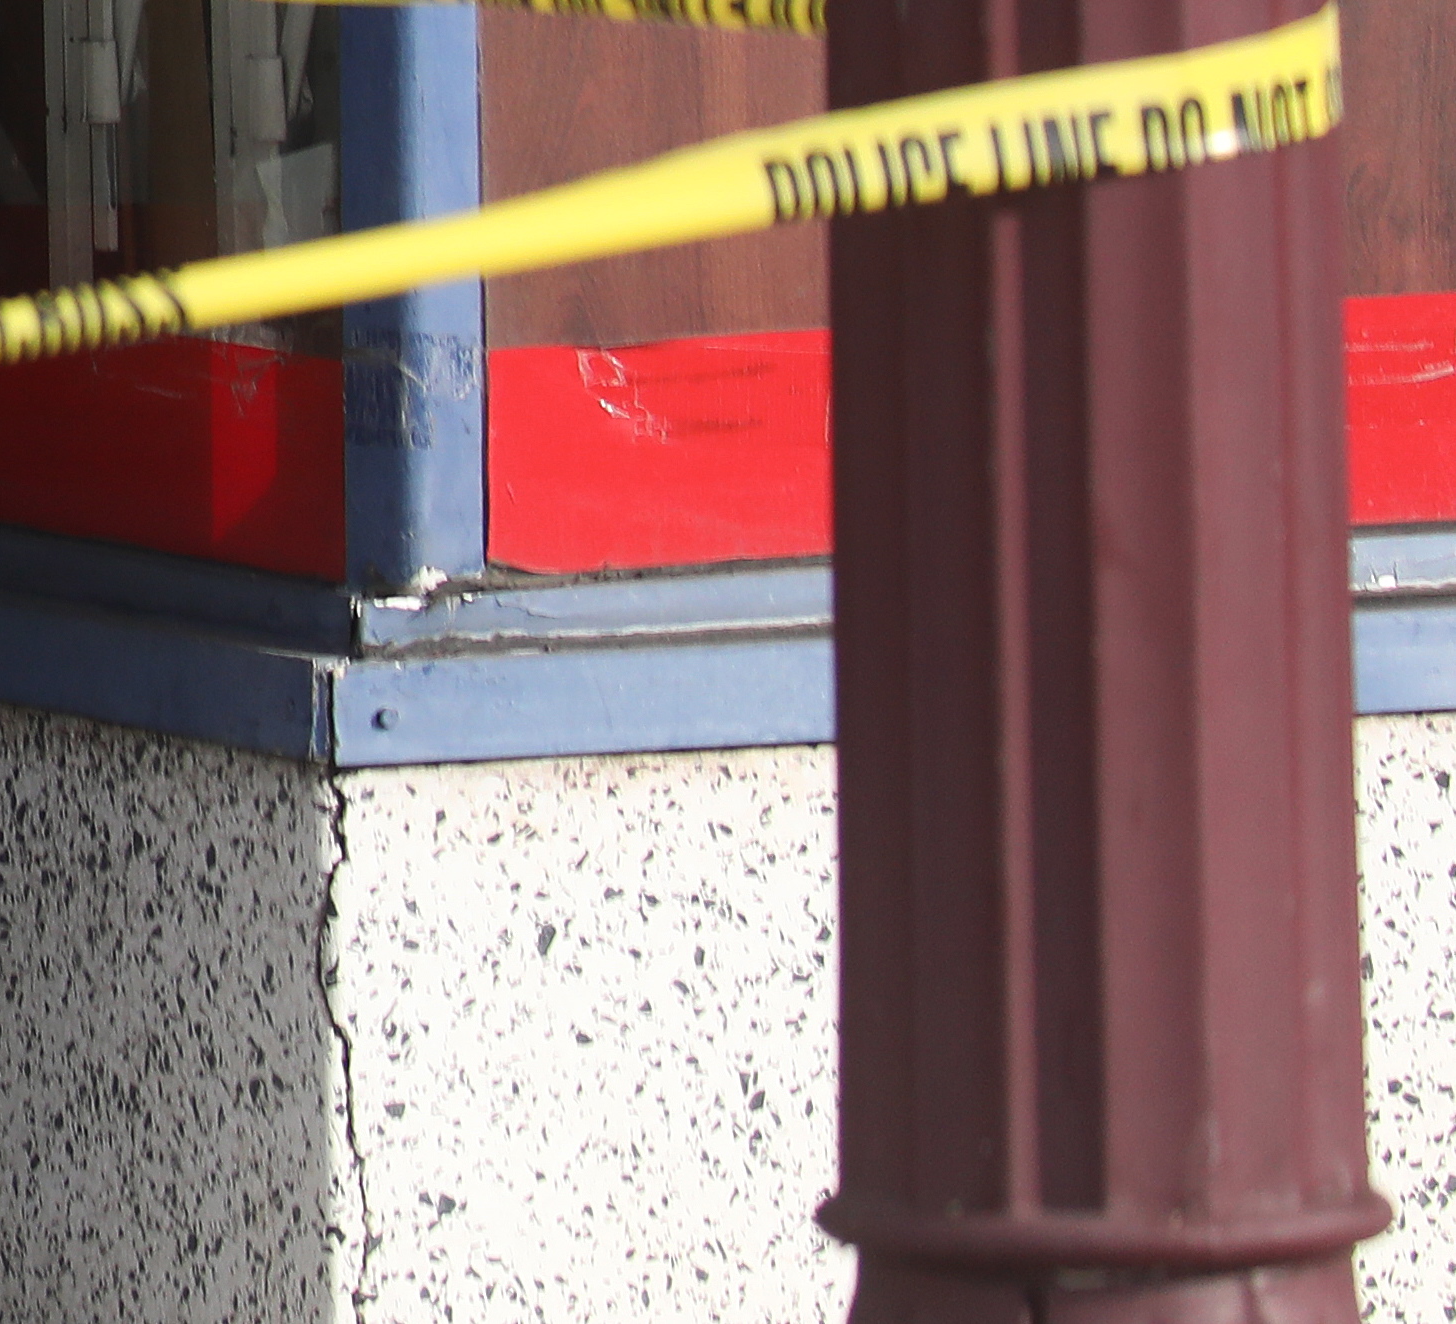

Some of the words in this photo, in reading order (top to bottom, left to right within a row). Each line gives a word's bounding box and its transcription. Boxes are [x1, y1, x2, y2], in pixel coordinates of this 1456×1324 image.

[763, 132, 966, 224] POLICE
[989, 110, 1117, 188] LINE
[1141, 98, 1207, 170] DO
